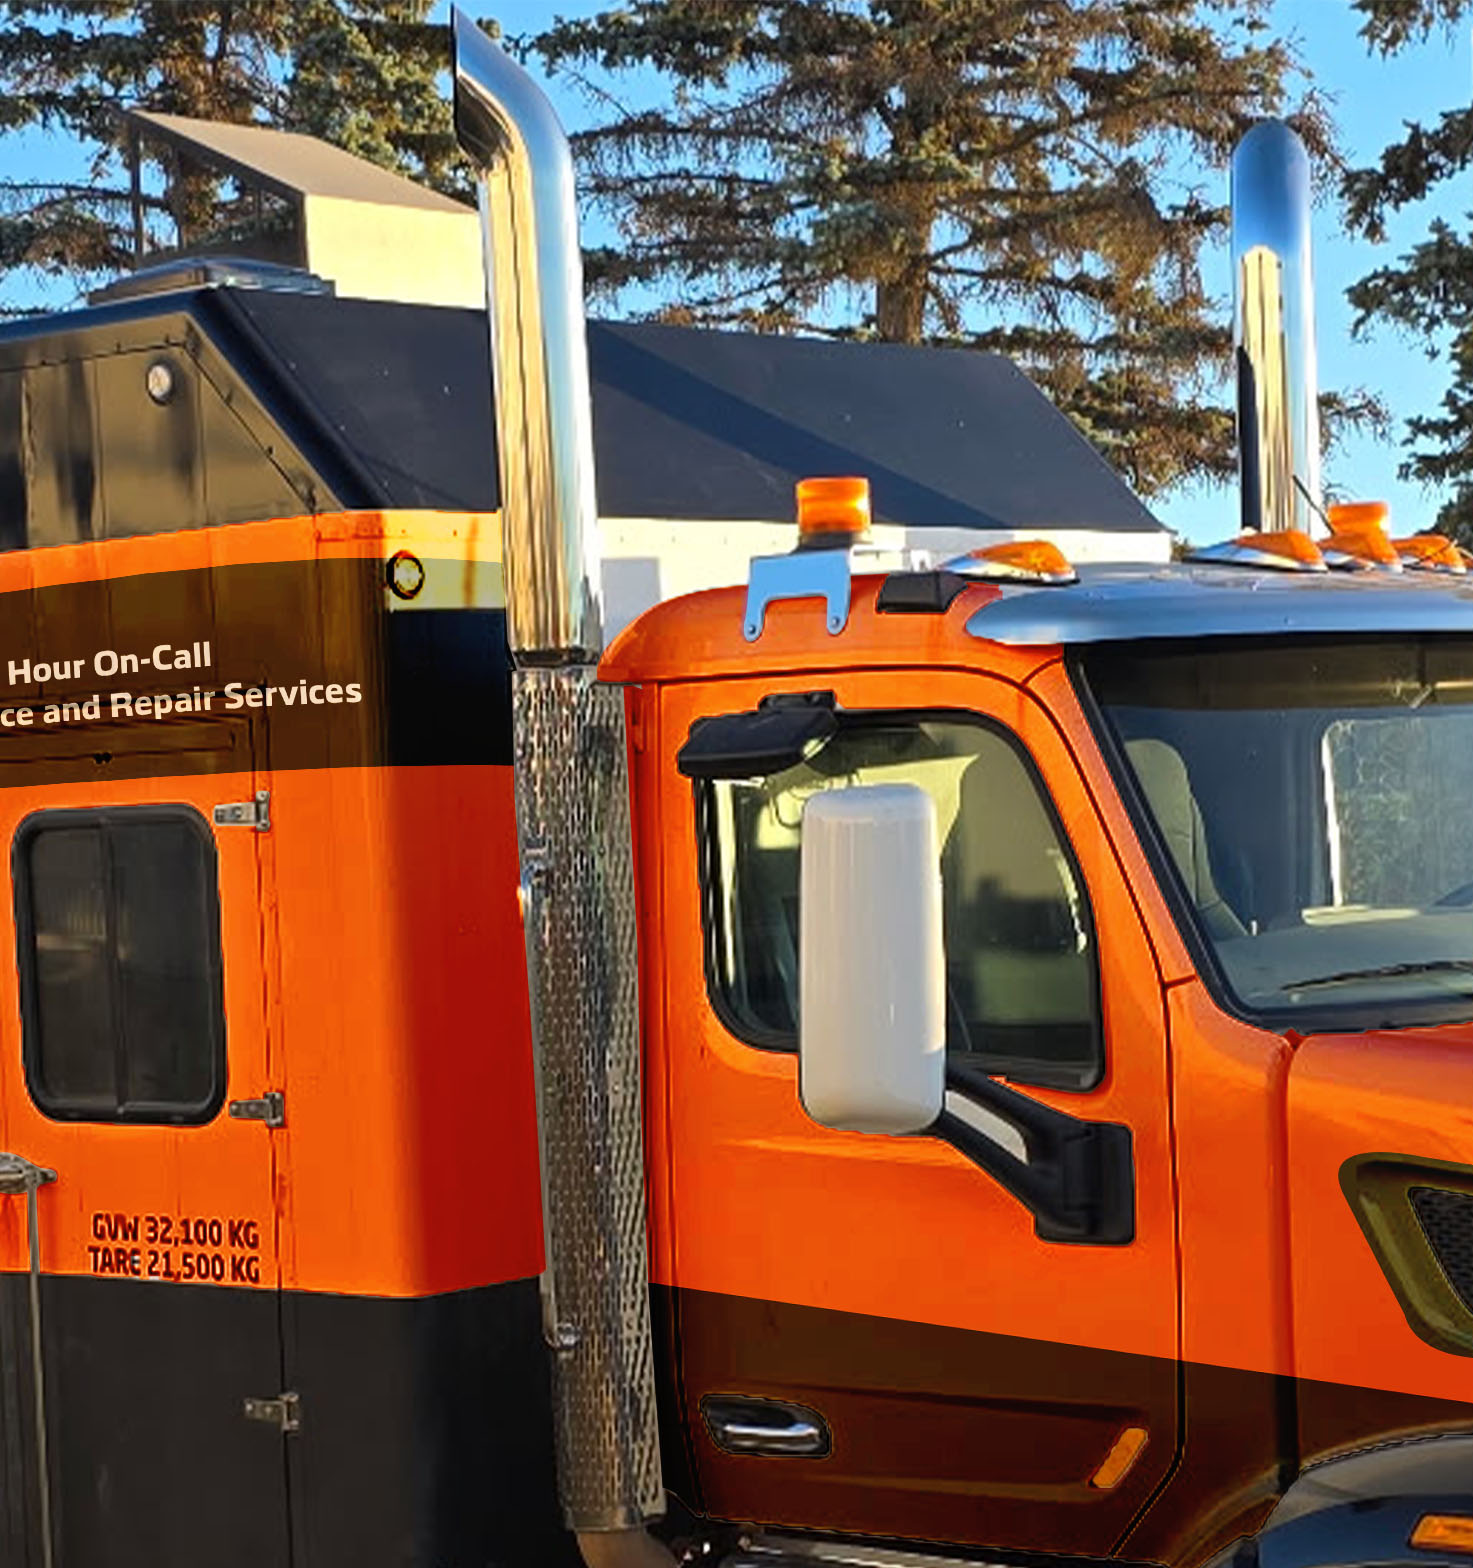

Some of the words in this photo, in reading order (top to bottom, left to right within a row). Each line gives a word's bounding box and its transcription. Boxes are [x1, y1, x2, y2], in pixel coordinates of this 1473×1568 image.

[8, 658, 86, 686] Hour
[93, 641, 212, 677] On-Call
[43, 694, 101, 724] and
[110, 687, 216, 720] Repair
[224, 679, 362, 710] Services
[93, 1213, 139, 1242] GVW
[145, 1216, 222, 1248] 32,100
[228, 1219, 259, 1250] KG
[88, 1245, 141, 1275] TARE
[147, 1249, 225, 1281] 21,500
[231, 1255, 260, 1284] KG
